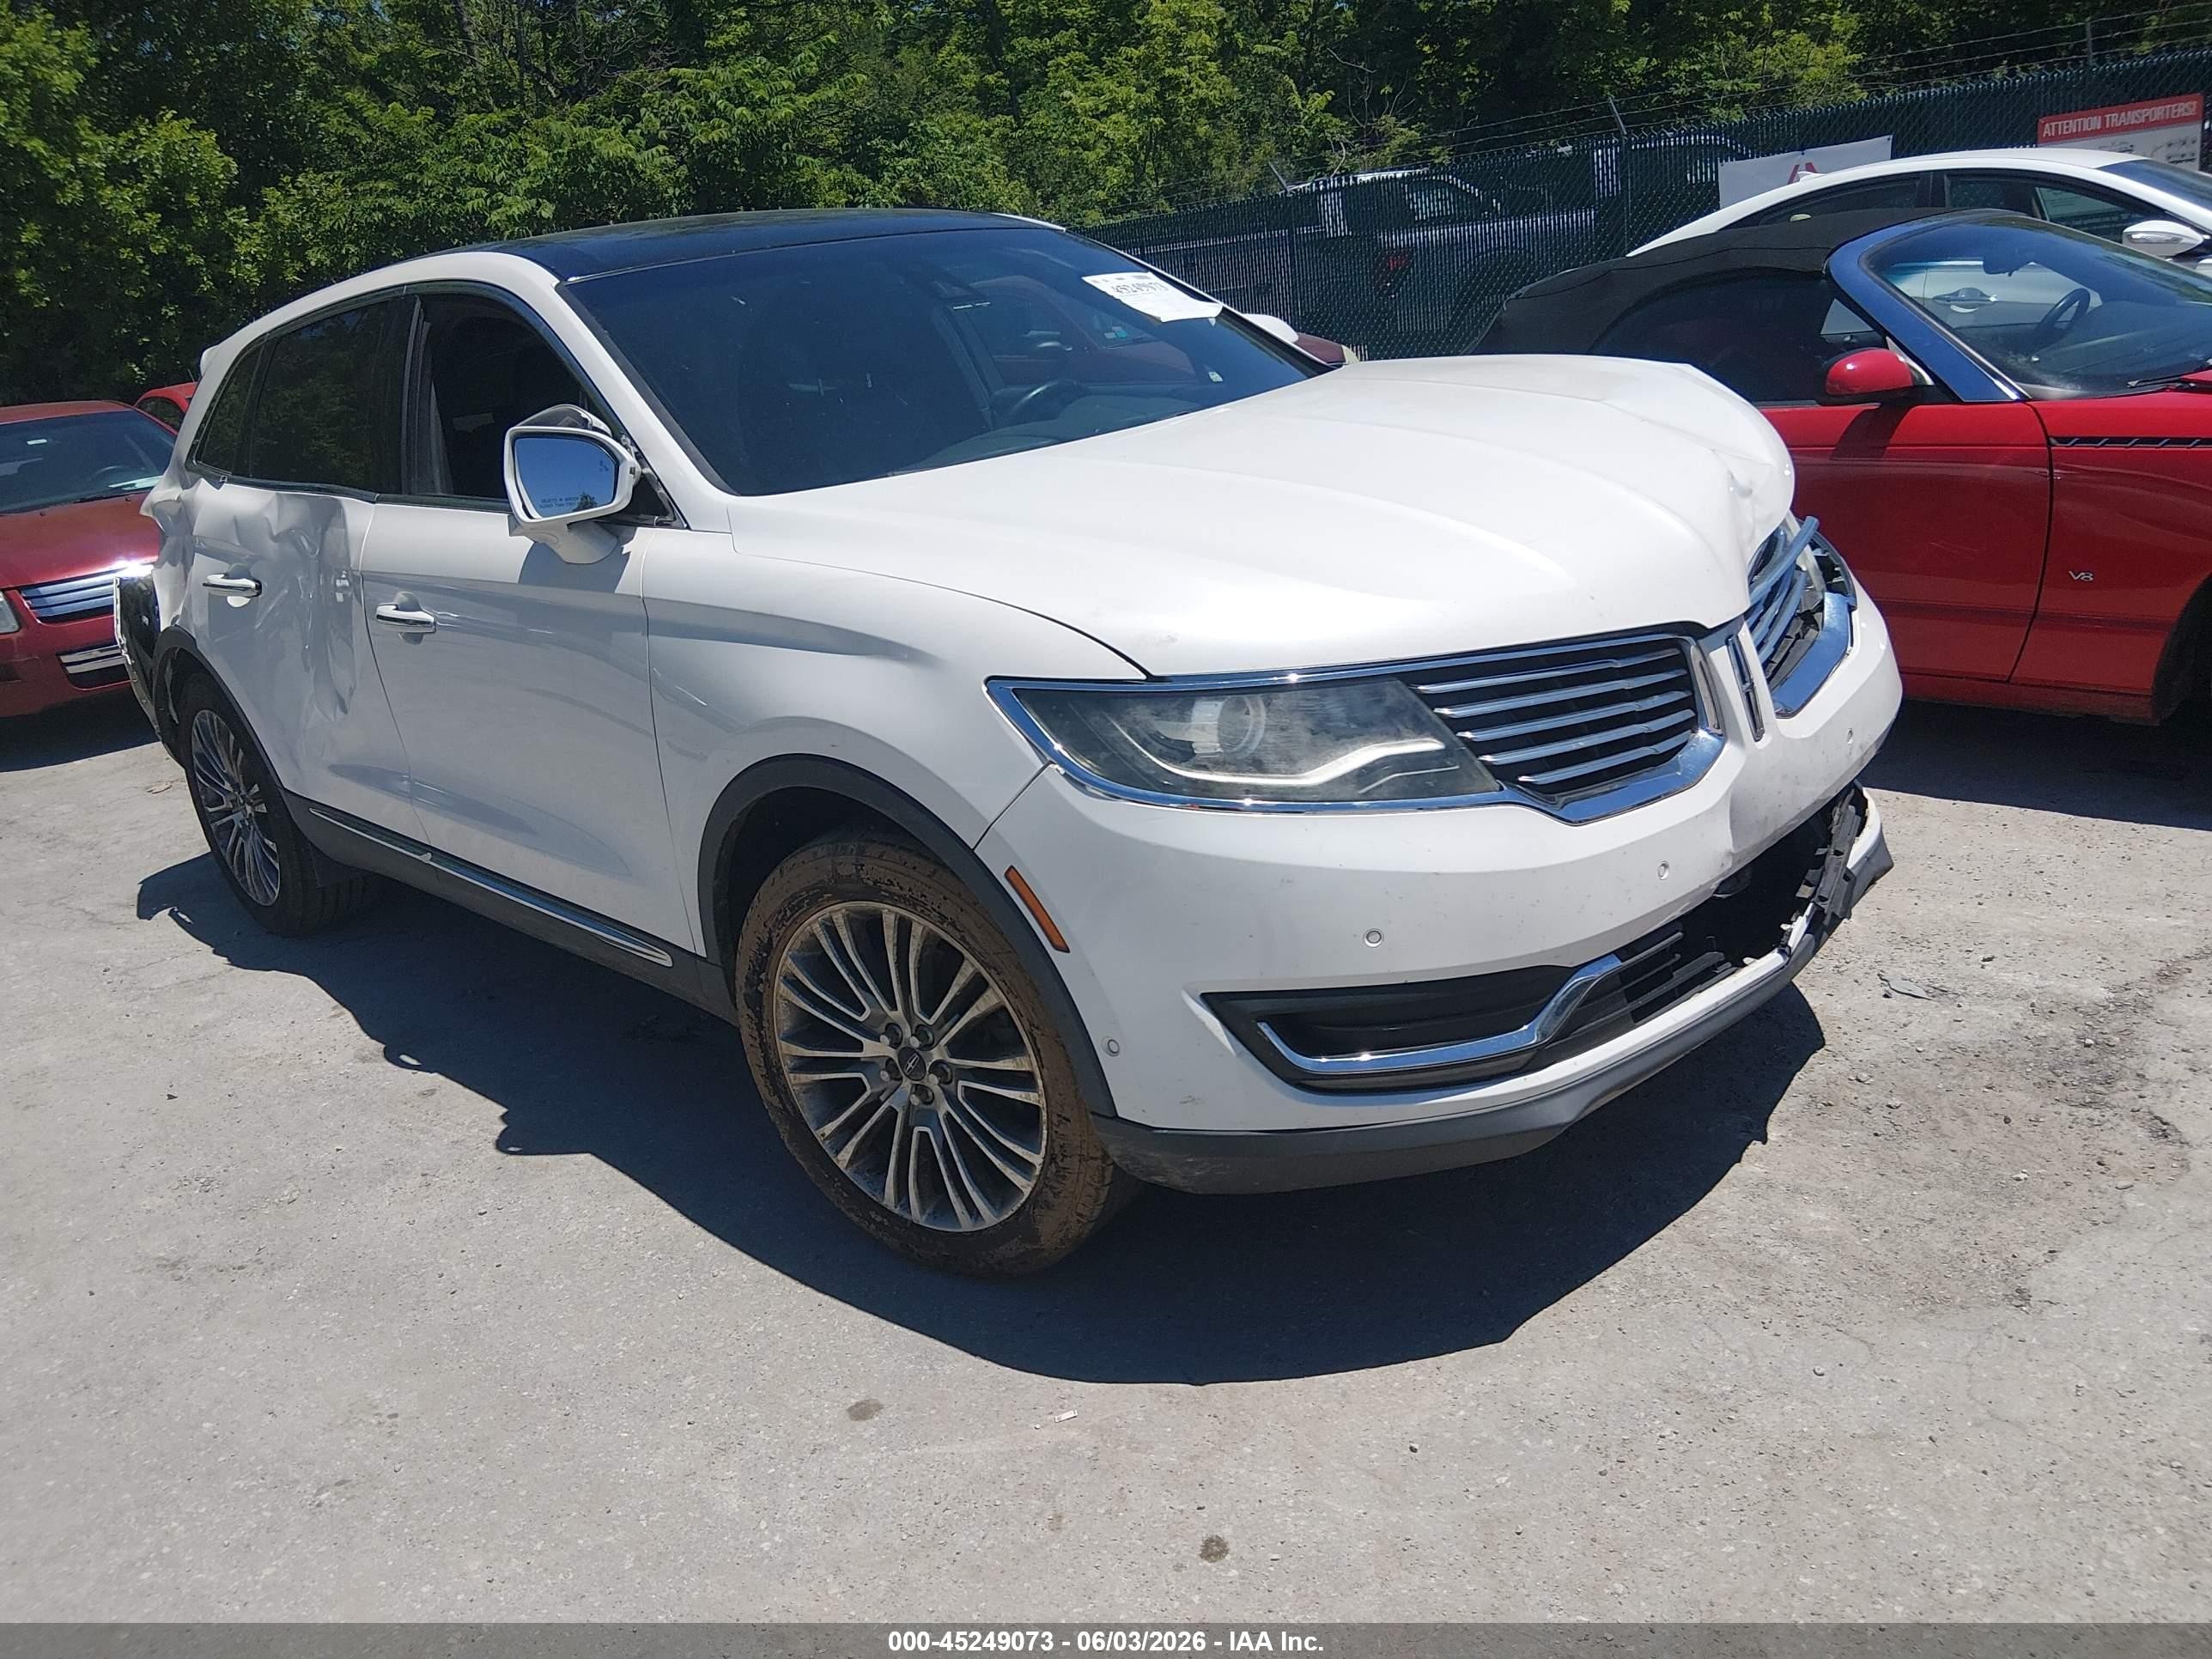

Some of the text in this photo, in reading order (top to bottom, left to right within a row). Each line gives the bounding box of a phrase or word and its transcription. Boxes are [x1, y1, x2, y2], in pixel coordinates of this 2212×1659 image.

[2043, 100, 2197, 137] ATTENTION TRANSPORTERS!
[2068, 570, 2094, 581] V8
